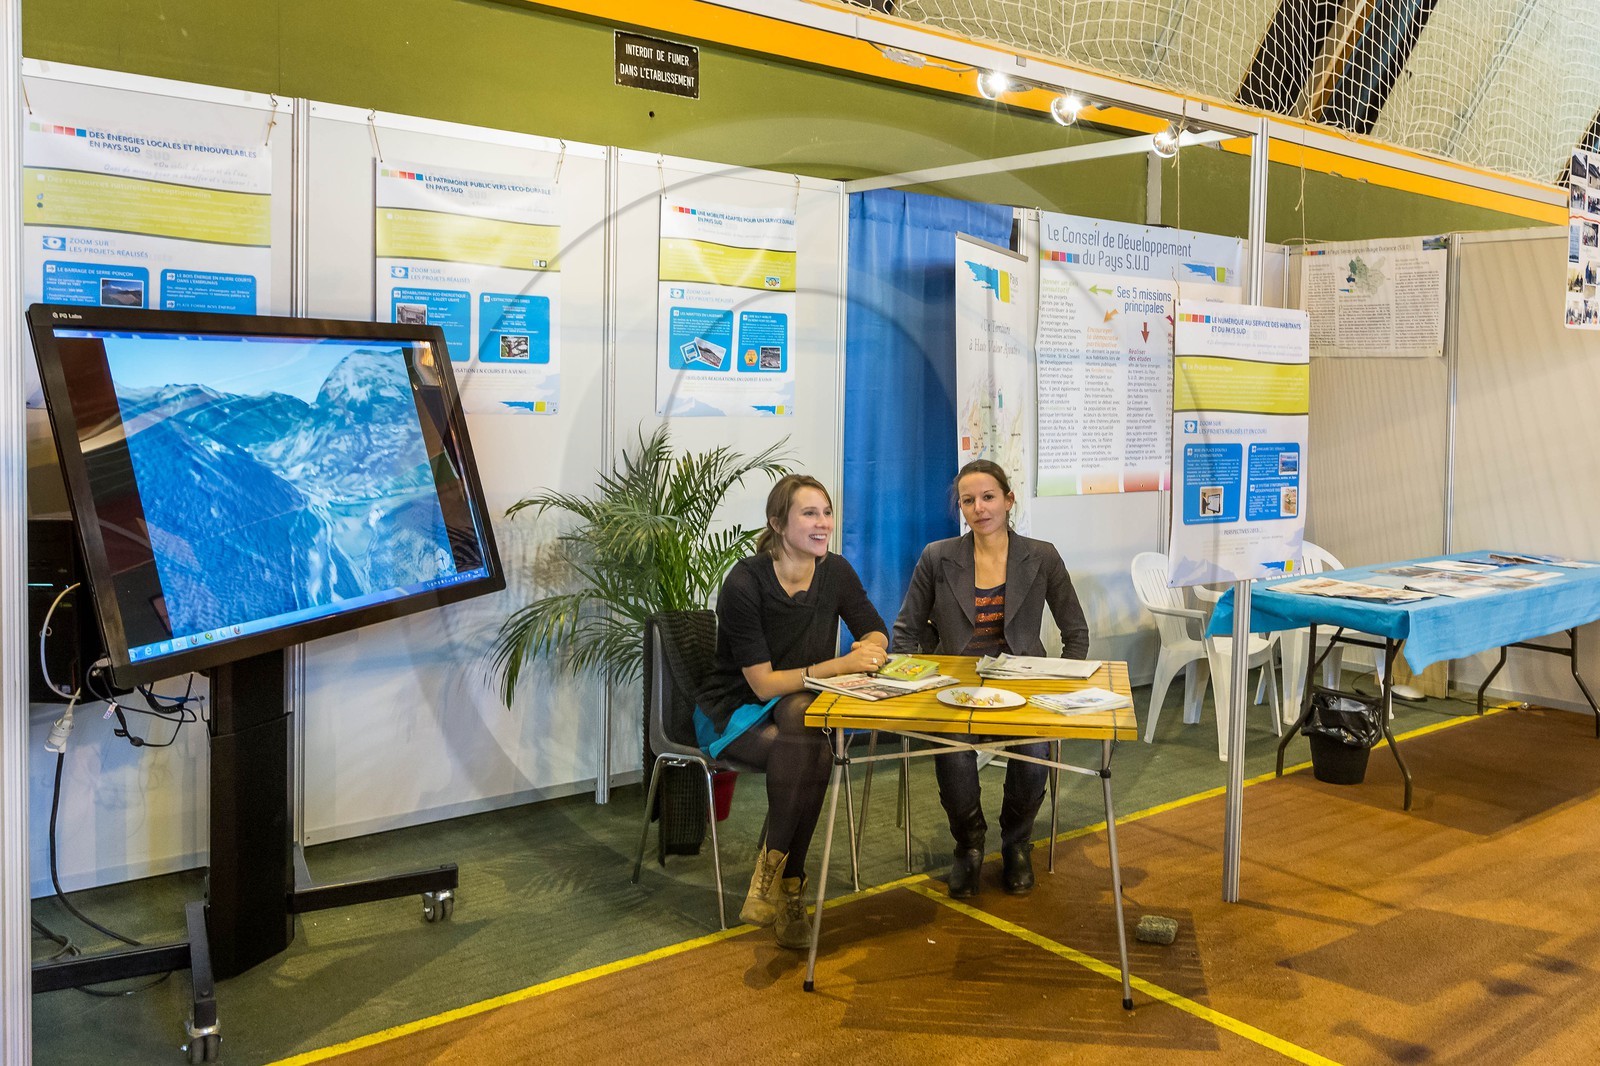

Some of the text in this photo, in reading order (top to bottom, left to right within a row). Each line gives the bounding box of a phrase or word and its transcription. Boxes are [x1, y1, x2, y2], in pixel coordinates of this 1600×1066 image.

[626, 44, 689, 66] INTERDIT DE FUMER
[620, 63, 694, 87] DANS L'ETABLISSEMENT
[89, 131, 104, 139] DES
[107, 133, 144, 145] ÉNERGIES
[147, 140, 181, 150] LOCALES
[195, 145, 256, 158] RENOUVELABLES
[103, 142, 121, 151] PAYS
[124, 145, 140, 153] SUD
[65, 178, 109, 188] ressources
[111, 183, 150, 192] naturelles
[152, 187, 211, 198] exceptionnelles
[433, 177, 468, 186] PATRIMOINE
[1047, 224, 1191, 258] Le Conseil de Développement
[117, 249, 148, 258] RÉALISÉS
[1082, 250, 1150, 271] du Pays S.U.D
[1117, 286, 1171, 302] Ses 5 missions
[1124, 301, 1164, 314] principales
[1218, 317, 1244, 326] NUMÉRIQUE
[969, 336, 973, 350] à
